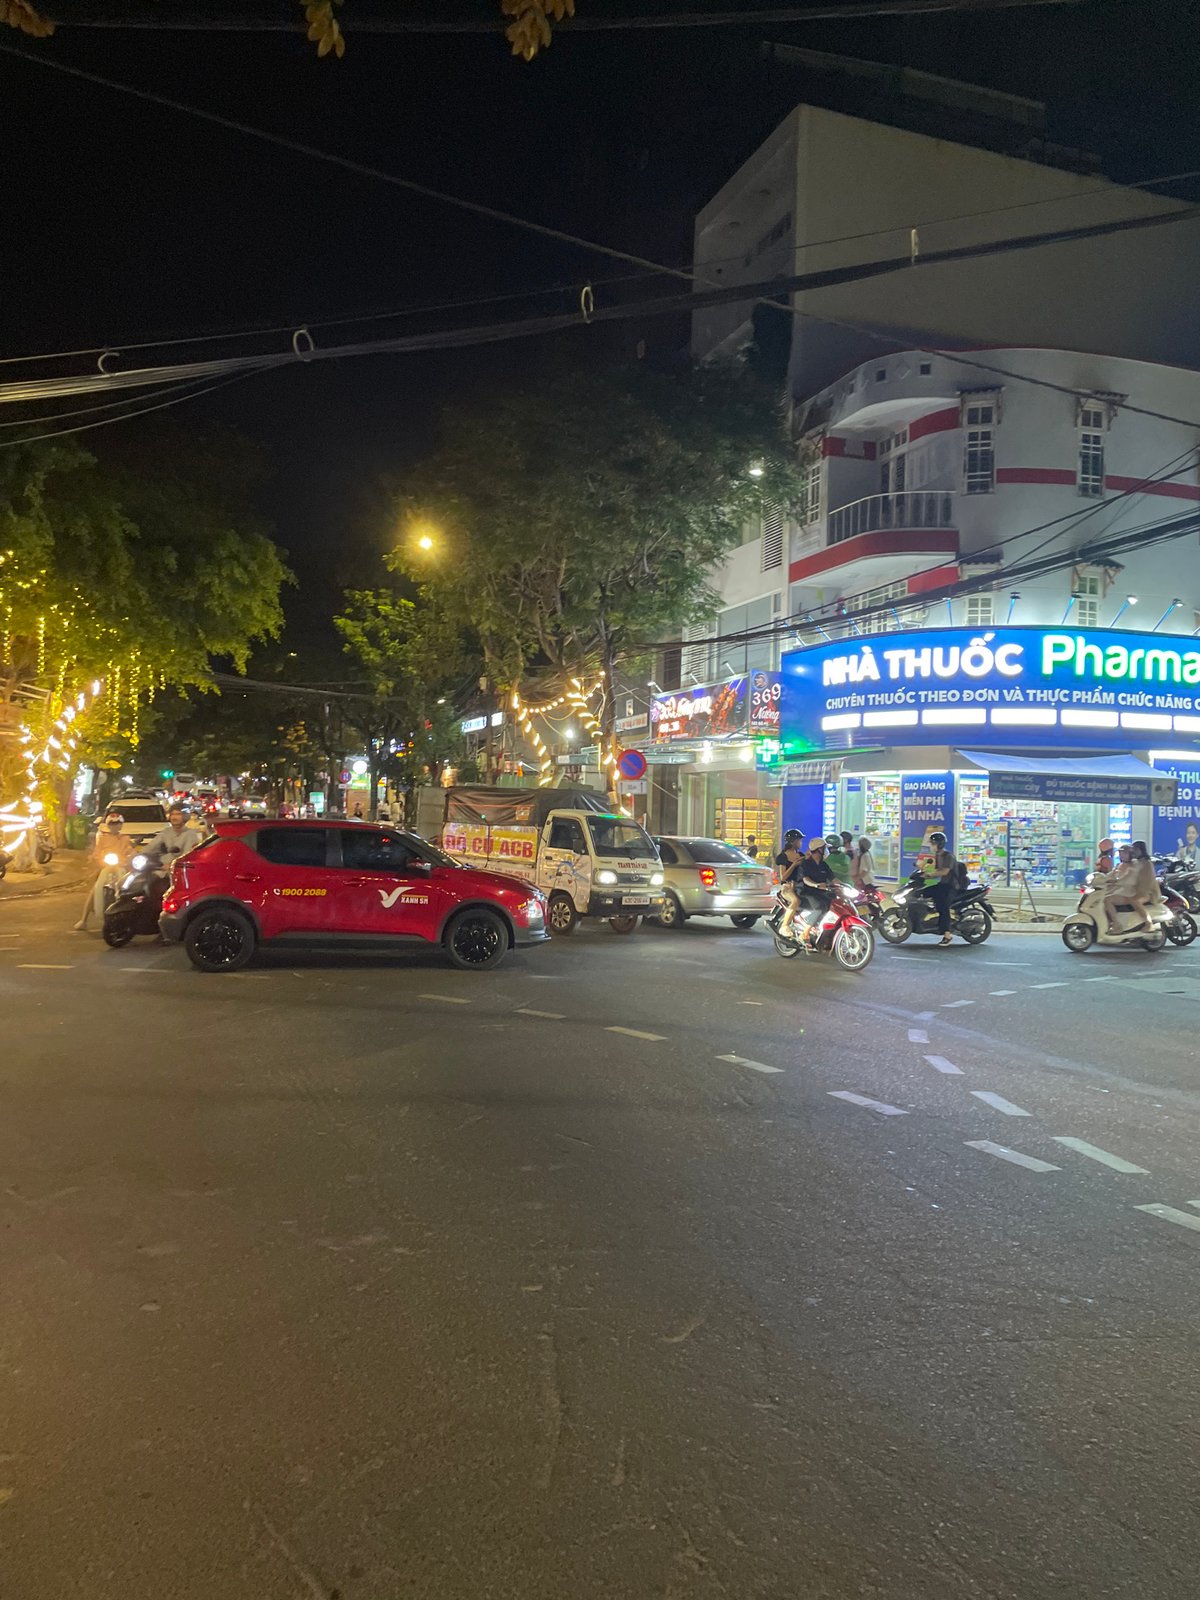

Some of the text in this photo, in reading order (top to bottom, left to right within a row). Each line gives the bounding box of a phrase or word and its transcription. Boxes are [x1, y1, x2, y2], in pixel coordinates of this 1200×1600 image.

[822, 646, 880, 686] NHÀ
[884, 633, 1024, 679] THUỐC
[752, 682, 781, 706] 369
[826, 692, 865, 710] CHUYÊN
[867, 686, 916, 705] THUỐC
[918, 689, 961, 703] THEO
[962, 687, 1000, 702] ĐƠN
[1003, 686, 1025, 702] VÀ
[1026, 688, 1070, 706] THỰC
[1072, 685, 1115, 705] PHẨM
[1117, 691, 1153, 707] CHỨC
[1155, 693, 1192, 710] NĂNG
[903, 778, 946, 791] GIAO HÀNG
[903, 793, 946, 806] MIỄN PHÍ
[903, 808, 945, 823] TẠI NHÀ
[500, 840, 533, 858] ACB
[281, 888, 327, 896] 1900 2088
[401, 896, 429, 905] XANH SM
